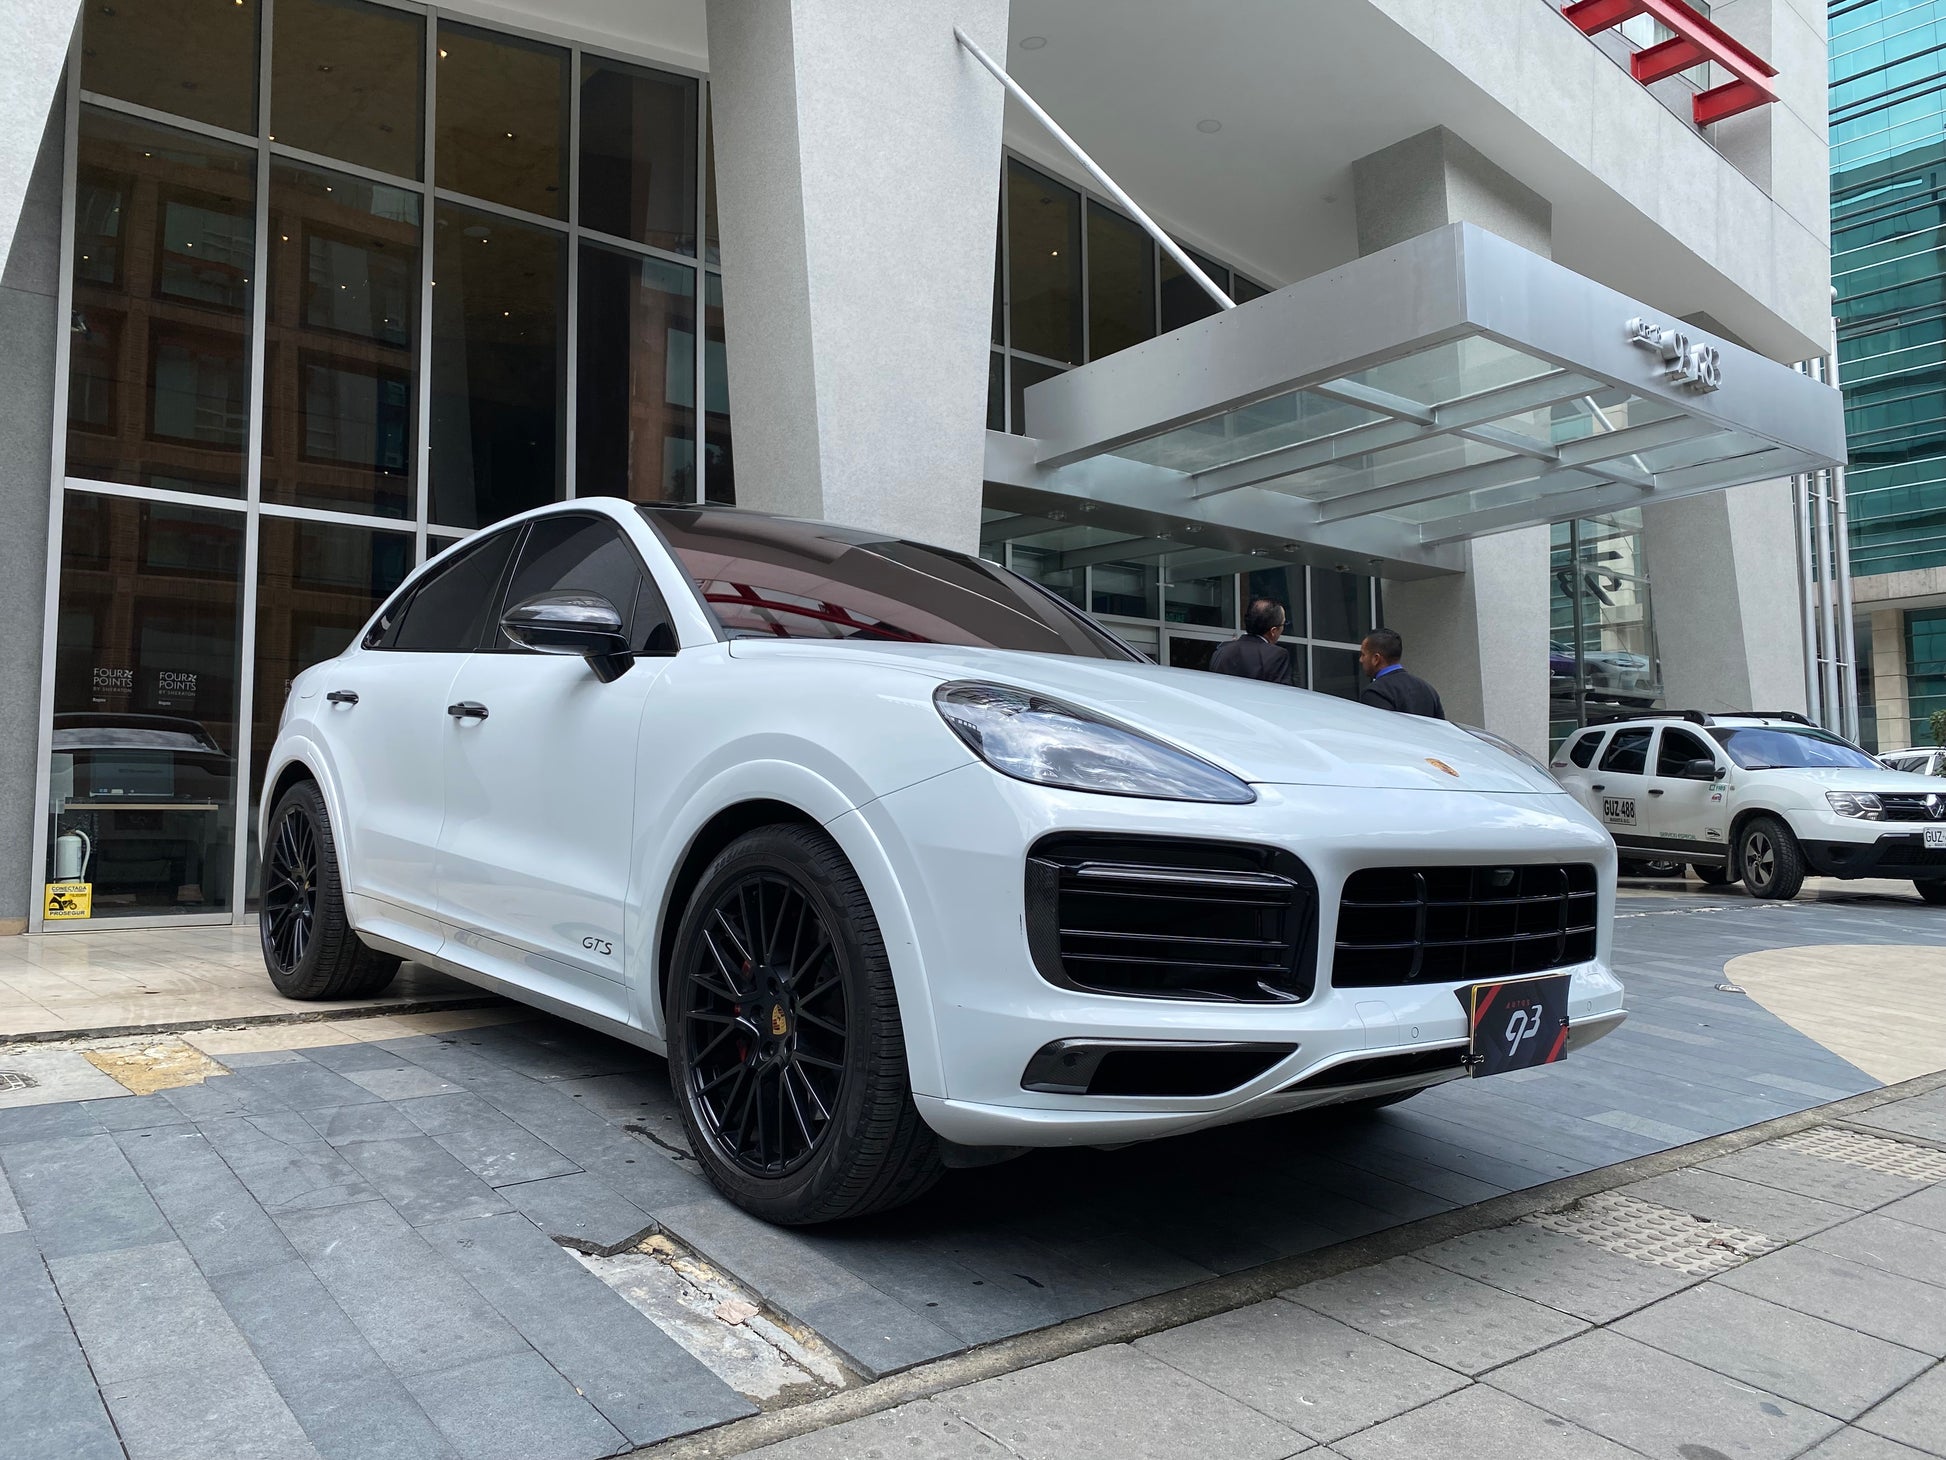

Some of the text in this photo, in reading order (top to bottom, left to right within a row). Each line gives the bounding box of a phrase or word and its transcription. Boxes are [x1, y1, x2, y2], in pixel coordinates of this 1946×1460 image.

[93, 668, 125, 678] FOUR
[159, 672, 188, 681] FOUR
[93, 677, 133, 687] POINTS
[159, 680, 197, 691] POINTS
[582, 936, 613, 955] GTS
[1506, 999, 1531, 1009] AUTOS
